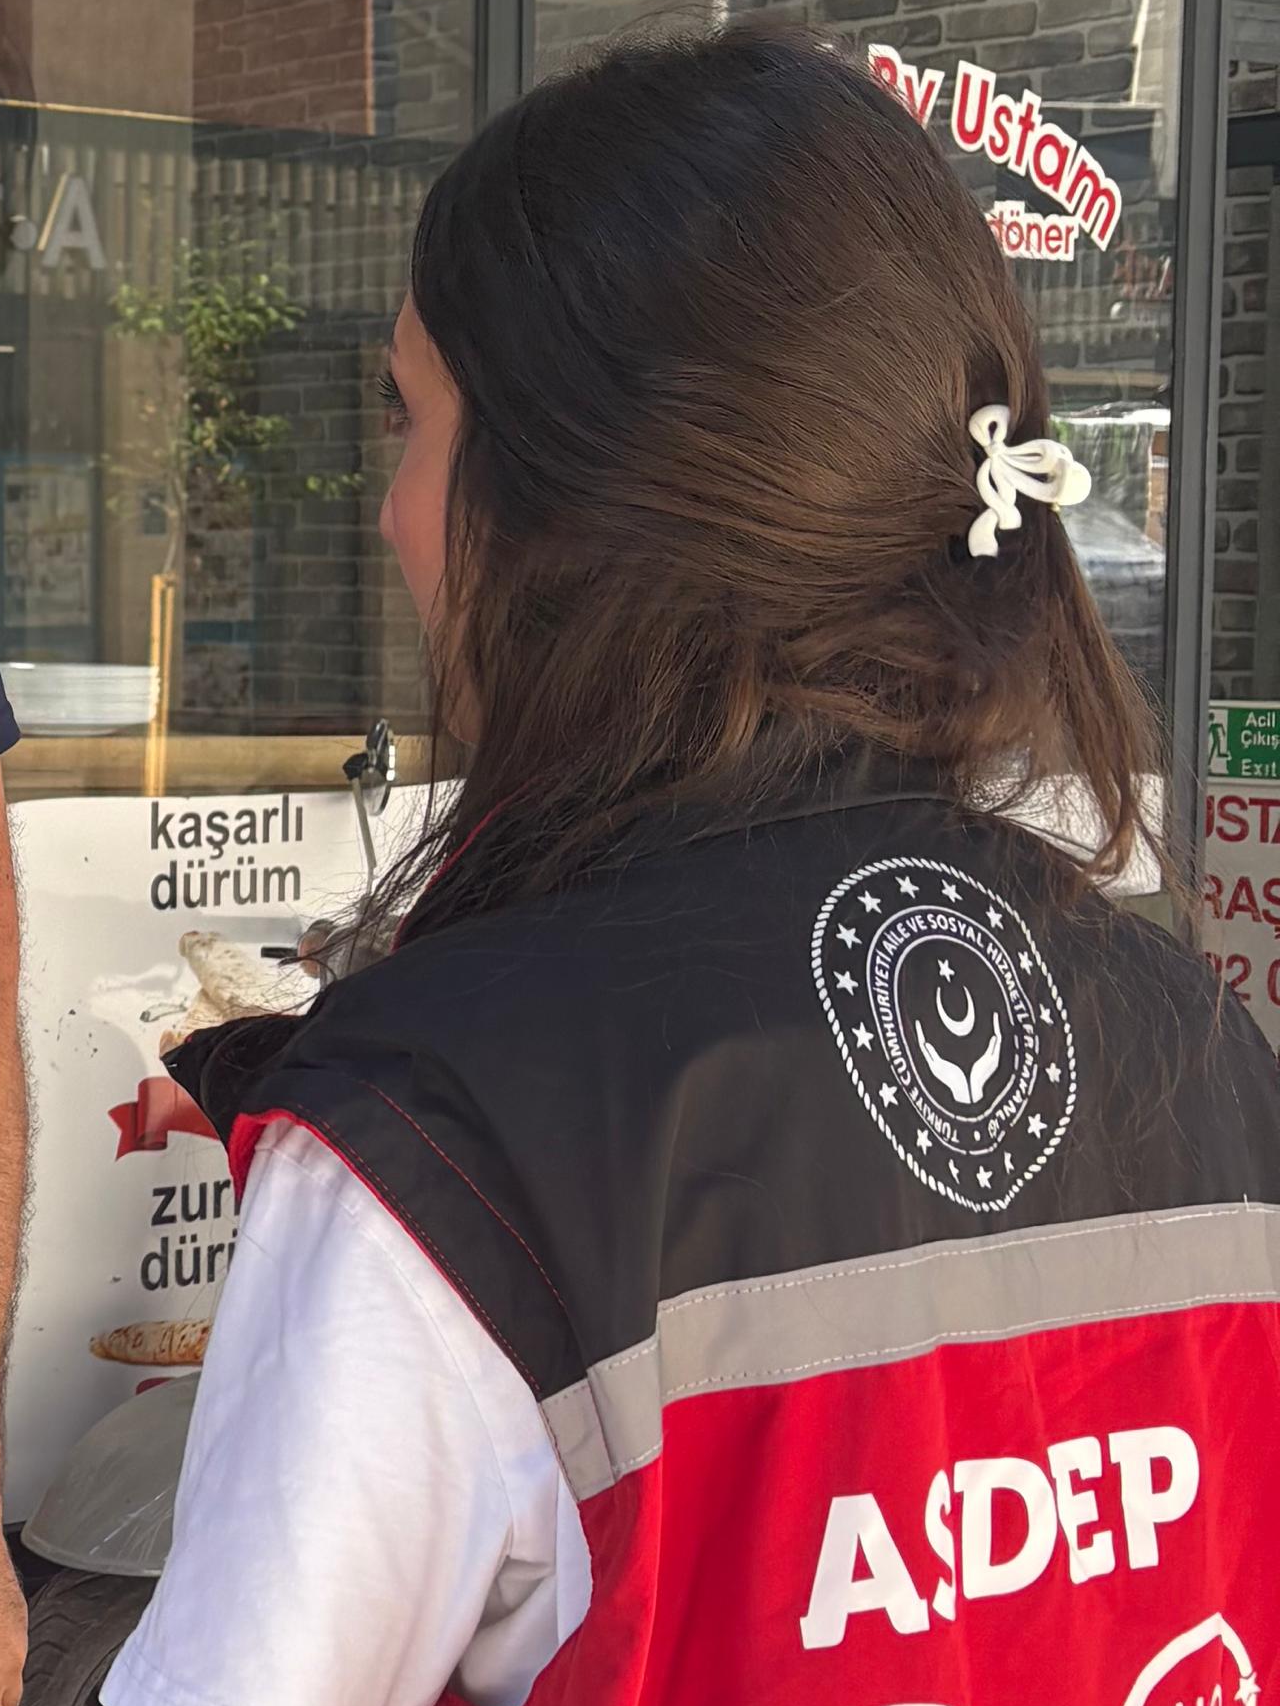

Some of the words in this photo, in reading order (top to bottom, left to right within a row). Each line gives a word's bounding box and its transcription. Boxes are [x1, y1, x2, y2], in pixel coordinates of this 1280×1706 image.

[955, 71, 1117, 241] Ustam
[1245, 711, 1276, 728] Acil
[151, 795, 304, 859] kaşarlı
[151, 858, 301, 910] dürüm
[907, 914, 928, 933] VE
[926, 913, 983, 949] SOSYAL
[151, 1179, 240, 1226] zur
[798, 1425, 1200, 1651] ASDEP
